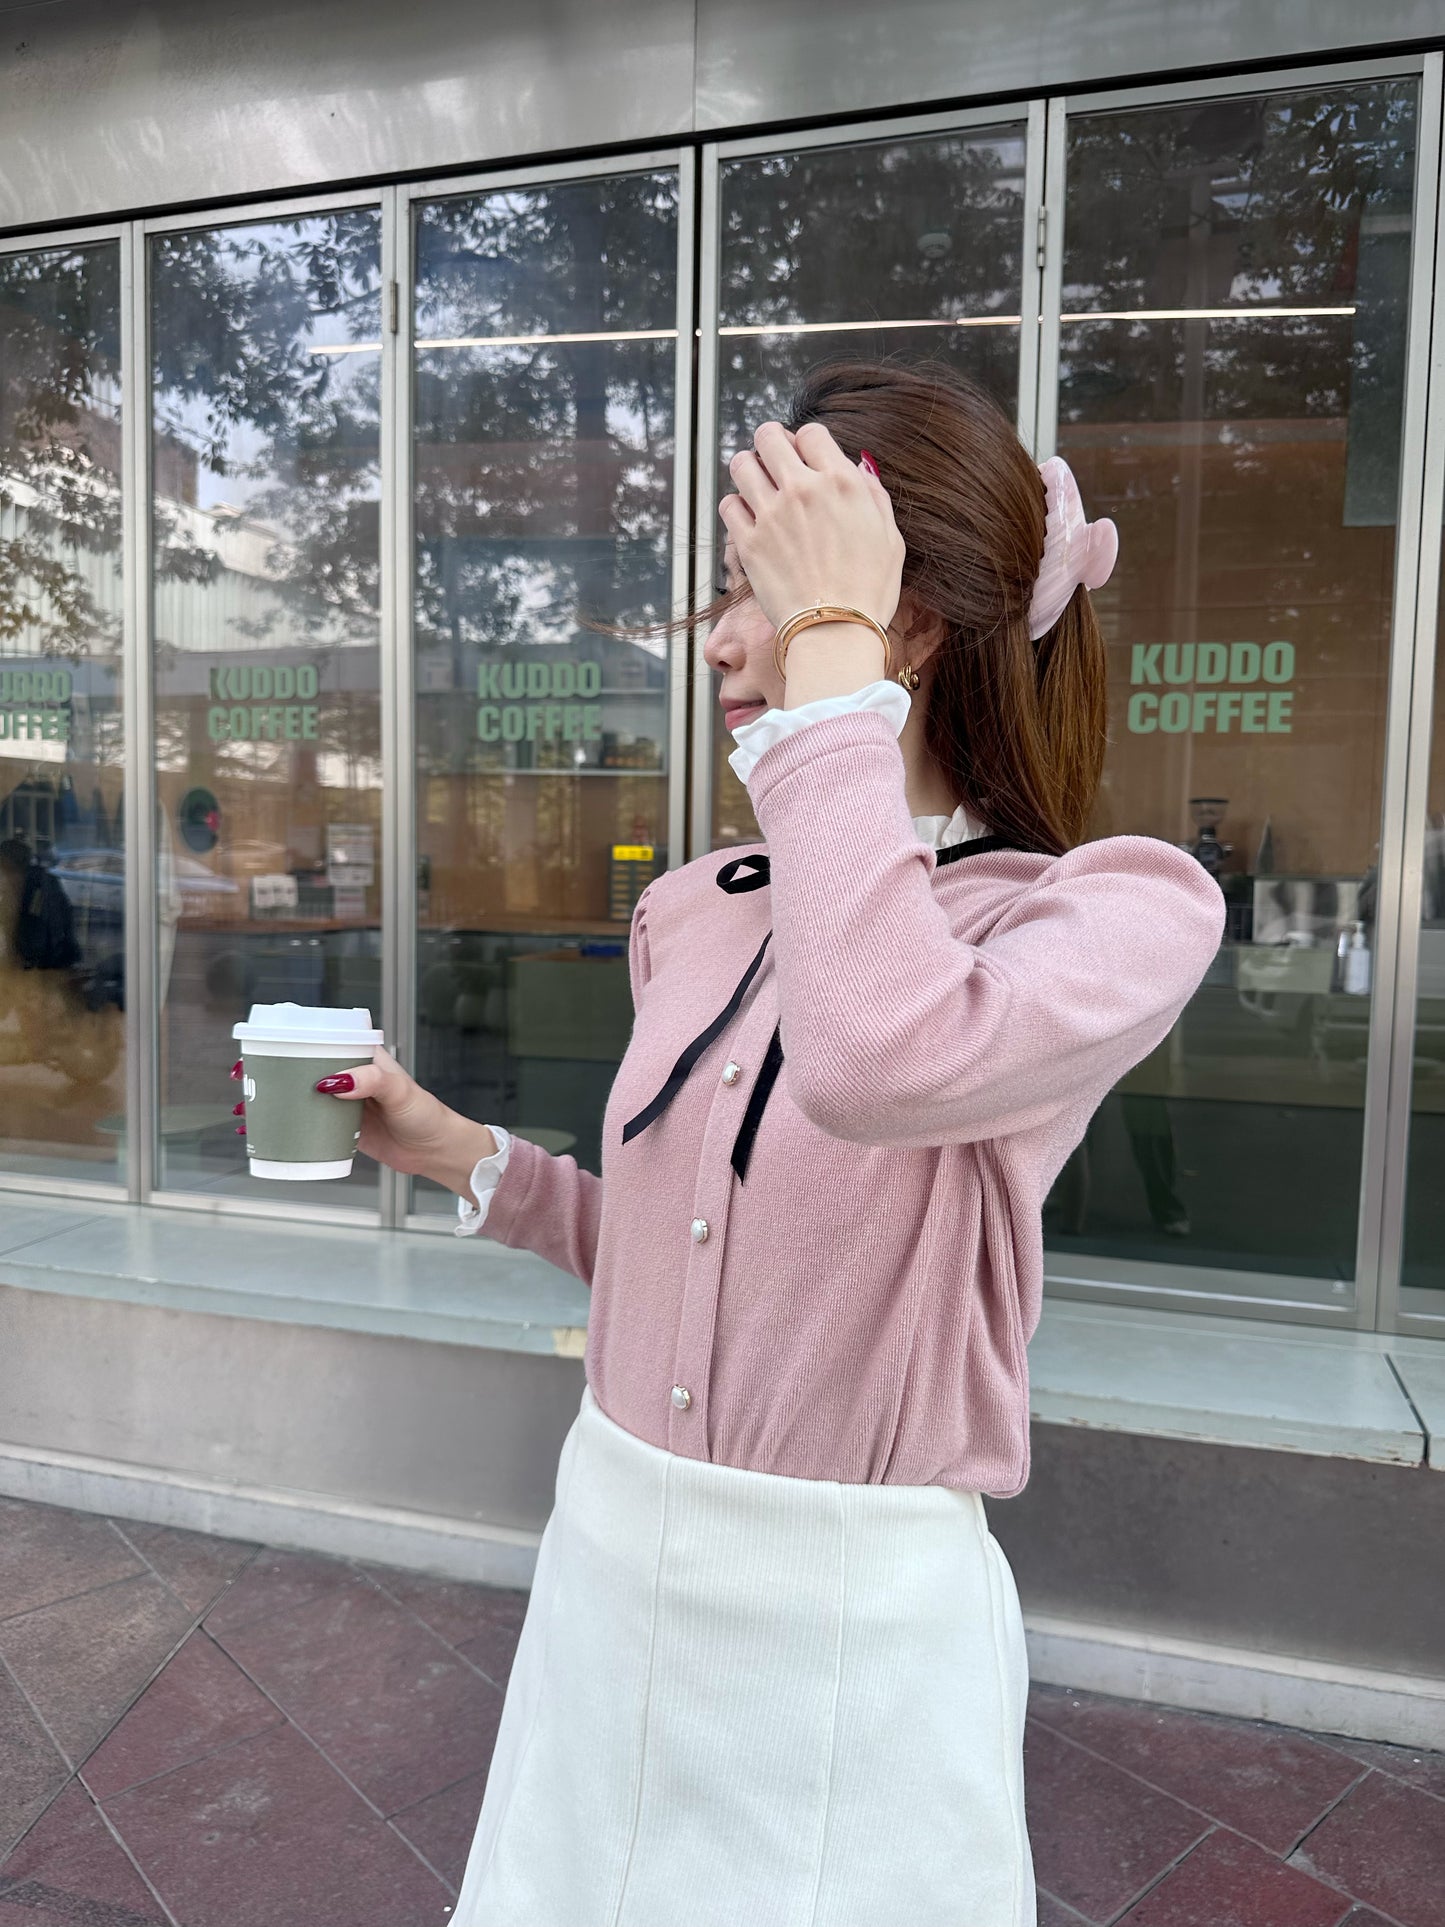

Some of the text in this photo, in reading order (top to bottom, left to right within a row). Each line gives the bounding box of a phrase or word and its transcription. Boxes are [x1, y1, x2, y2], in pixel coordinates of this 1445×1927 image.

[478, 662, 600, 699] KUDDO
[1130, 641, 1295, 685] KUDDO
[210, 664, 318, 700] KUDDO
[208, 705, 318, 741] COFFEE
[477, 705, 600, 742] COFFEE
[1127, 691, 1293, 734] COFFEE
